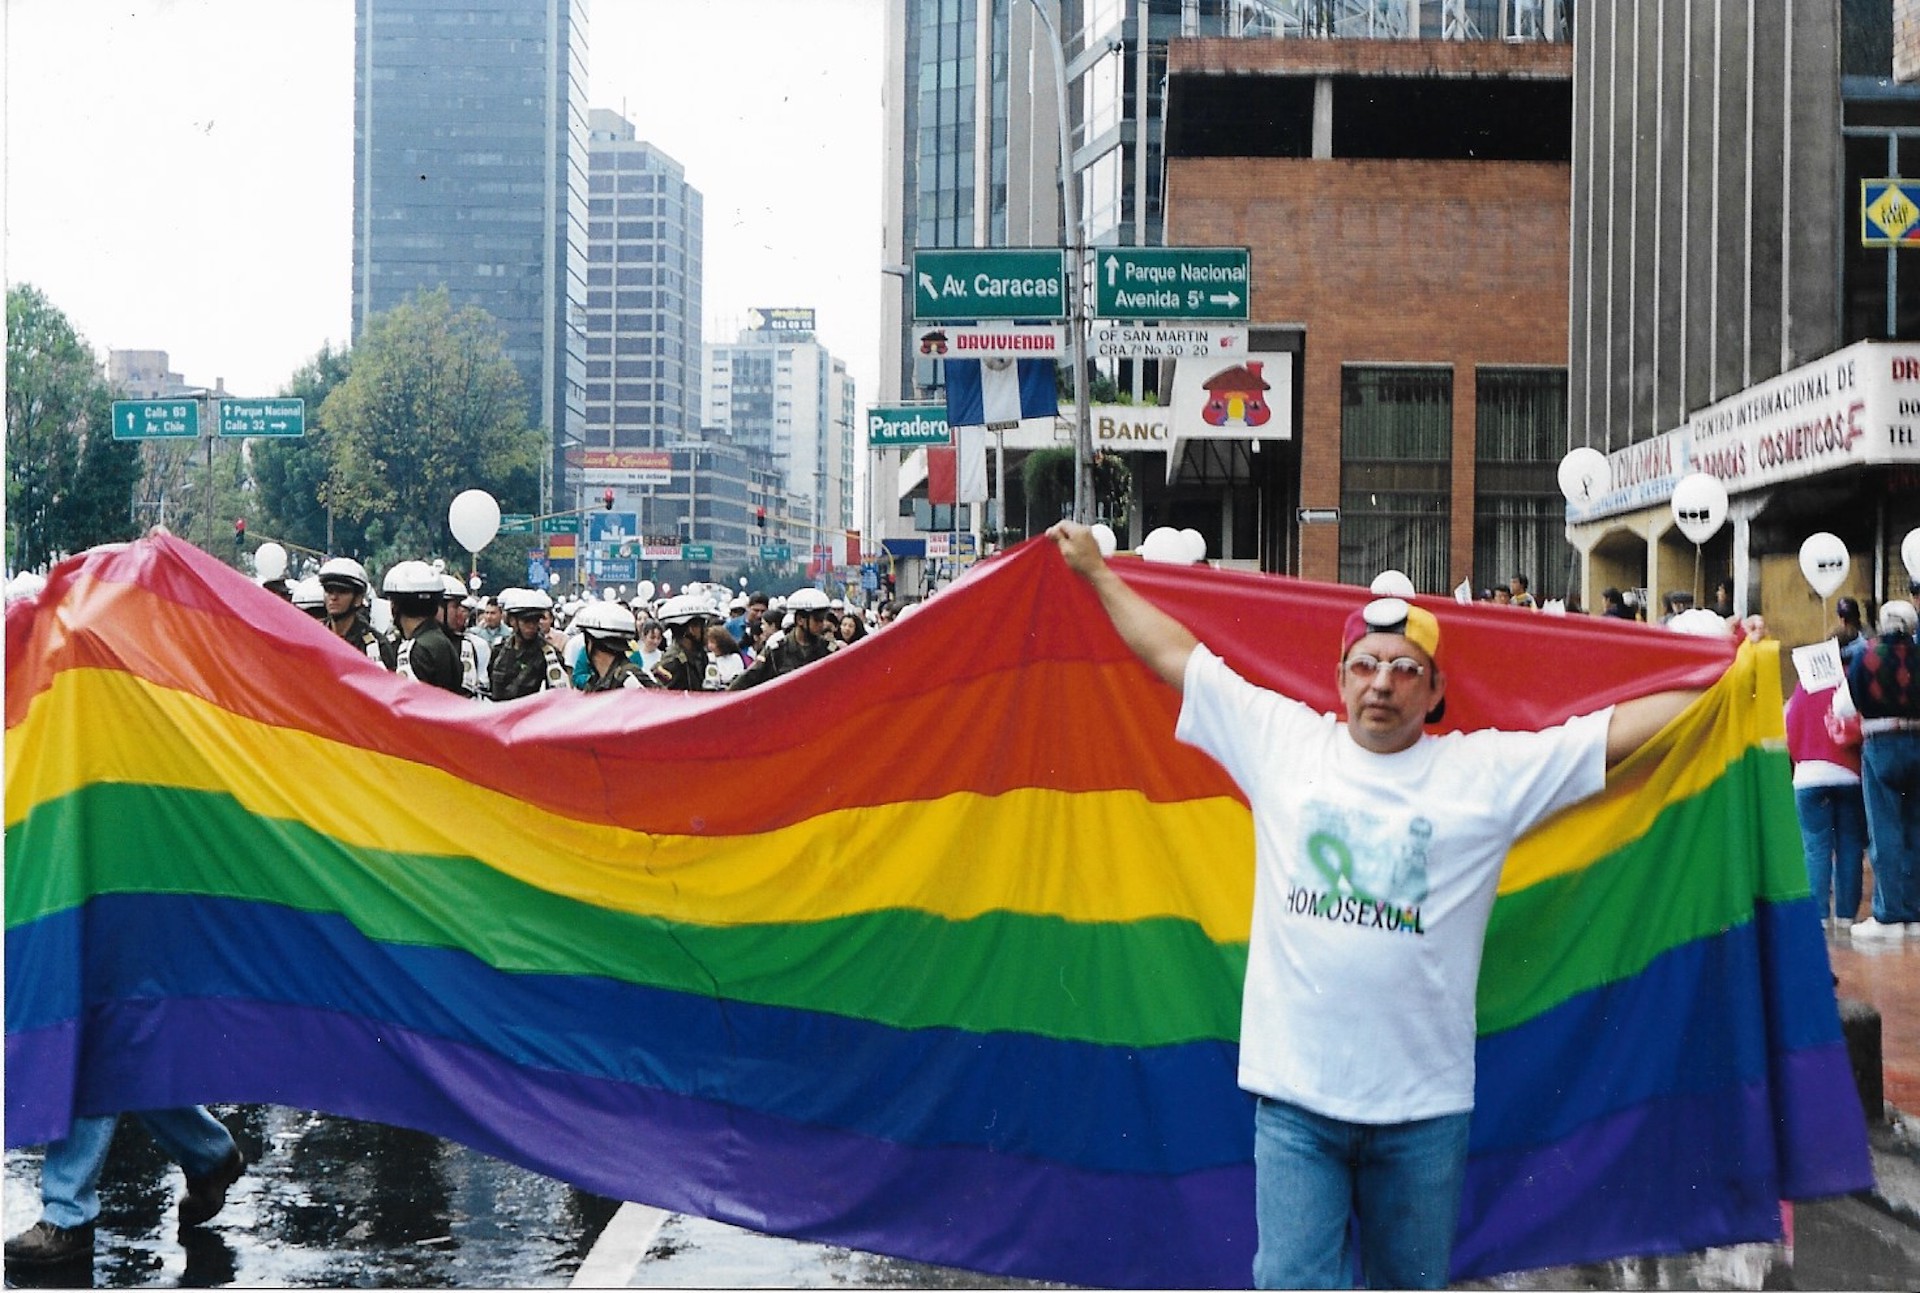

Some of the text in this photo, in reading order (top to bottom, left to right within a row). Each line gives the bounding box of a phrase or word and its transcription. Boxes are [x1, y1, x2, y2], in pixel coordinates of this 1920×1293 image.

[1125, 262, 1246, 286] Parque Nacional
[942, 273, 1059, 298] Av. Caracas
[1115, 289, 1180, 309] Avenida
[957, 334, 1055, 350] DAVIVIENDA
[1123, 330, 1151, 341] SAN
[1156, 330, 1208, 342] MARTIN
[1167, 344, 1184, 356] 30
[1193, 344, 1209, 356] 20
[1694, 359, 1856, 441] CENTRO INTERNACIONAL DE
[145, 407, 167, 418] Calle
[234, 405, 301, 418] Parque Nacional
[146, 421, 185, 432] Av. Chile
[225, 420, 266, 431] Calle 32
[870, 414, 949, 439] Paradero
[1887, 425, 1912, 446] TEL
[1758, 411, 1845, 470] COSMETICOS
[1618, 434, 1673, 489] COLOMBIA
[1287, 884, 1425, 936] HOMOSEXUAL
